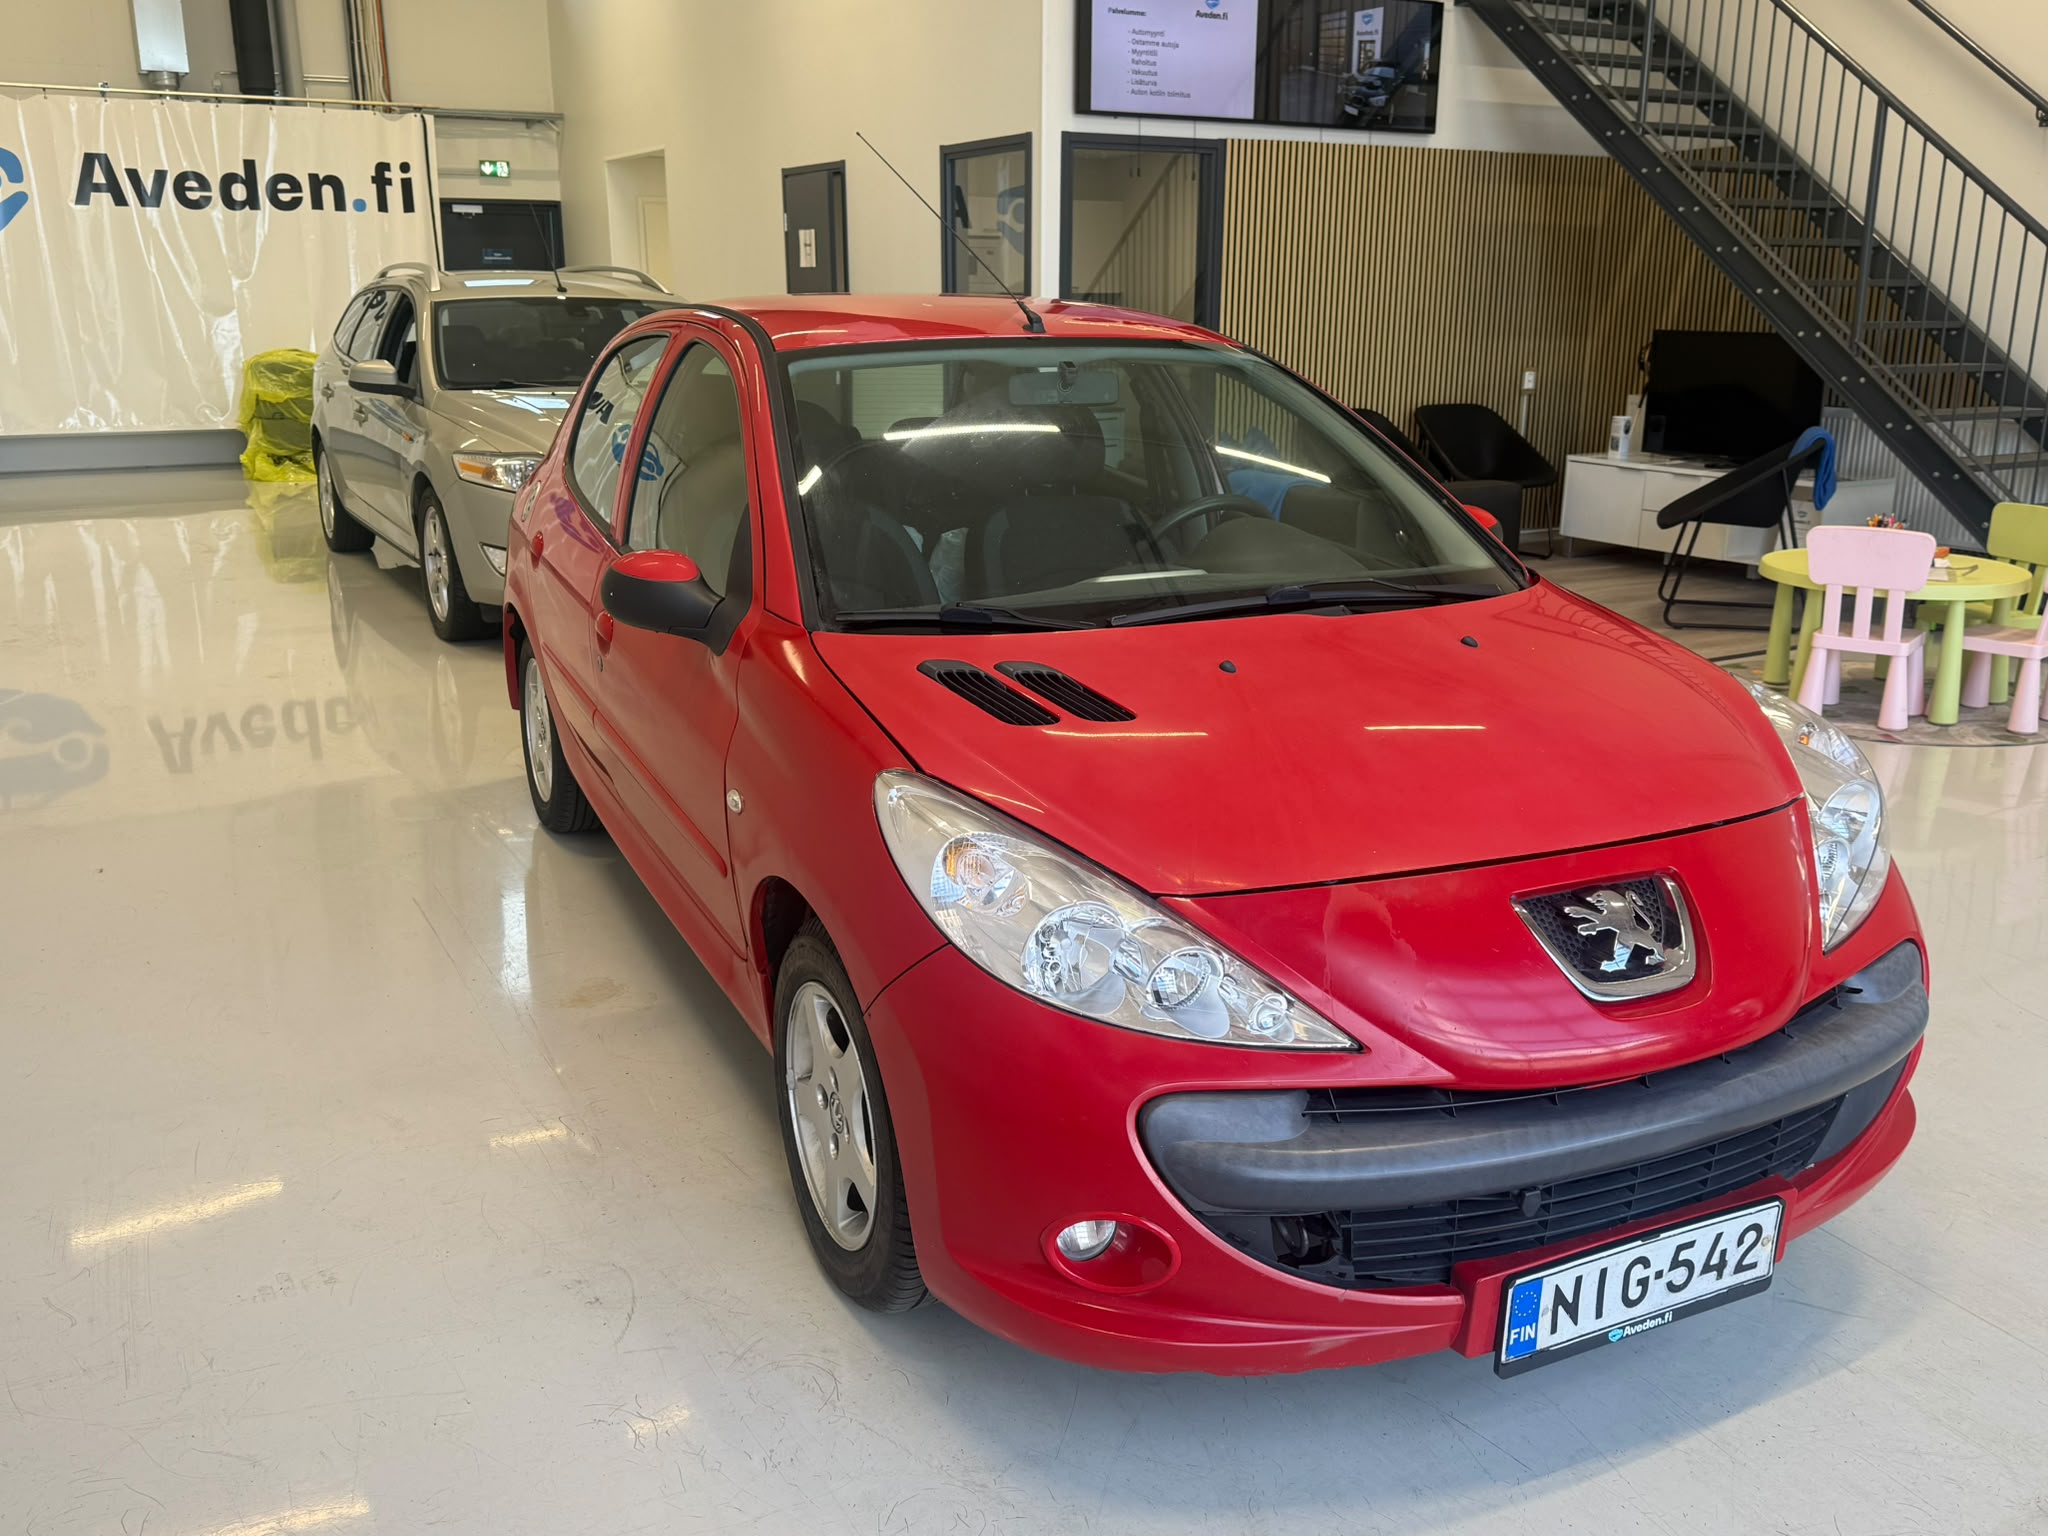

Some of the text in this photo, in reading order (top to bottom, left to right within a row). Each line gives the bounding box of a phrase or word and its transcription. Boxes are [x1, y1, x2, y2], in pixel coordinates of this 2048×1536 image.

[1195, 9, 1229, 21] Aveden.fi
[74, 152, 416, 214] Aveden.fi
[1550, 1222, 1763, 1335] NIG-542
[1509, 1322, 1536, 1346] FIN
[1622, 1310, 1673, 1338] Aveden.fi
